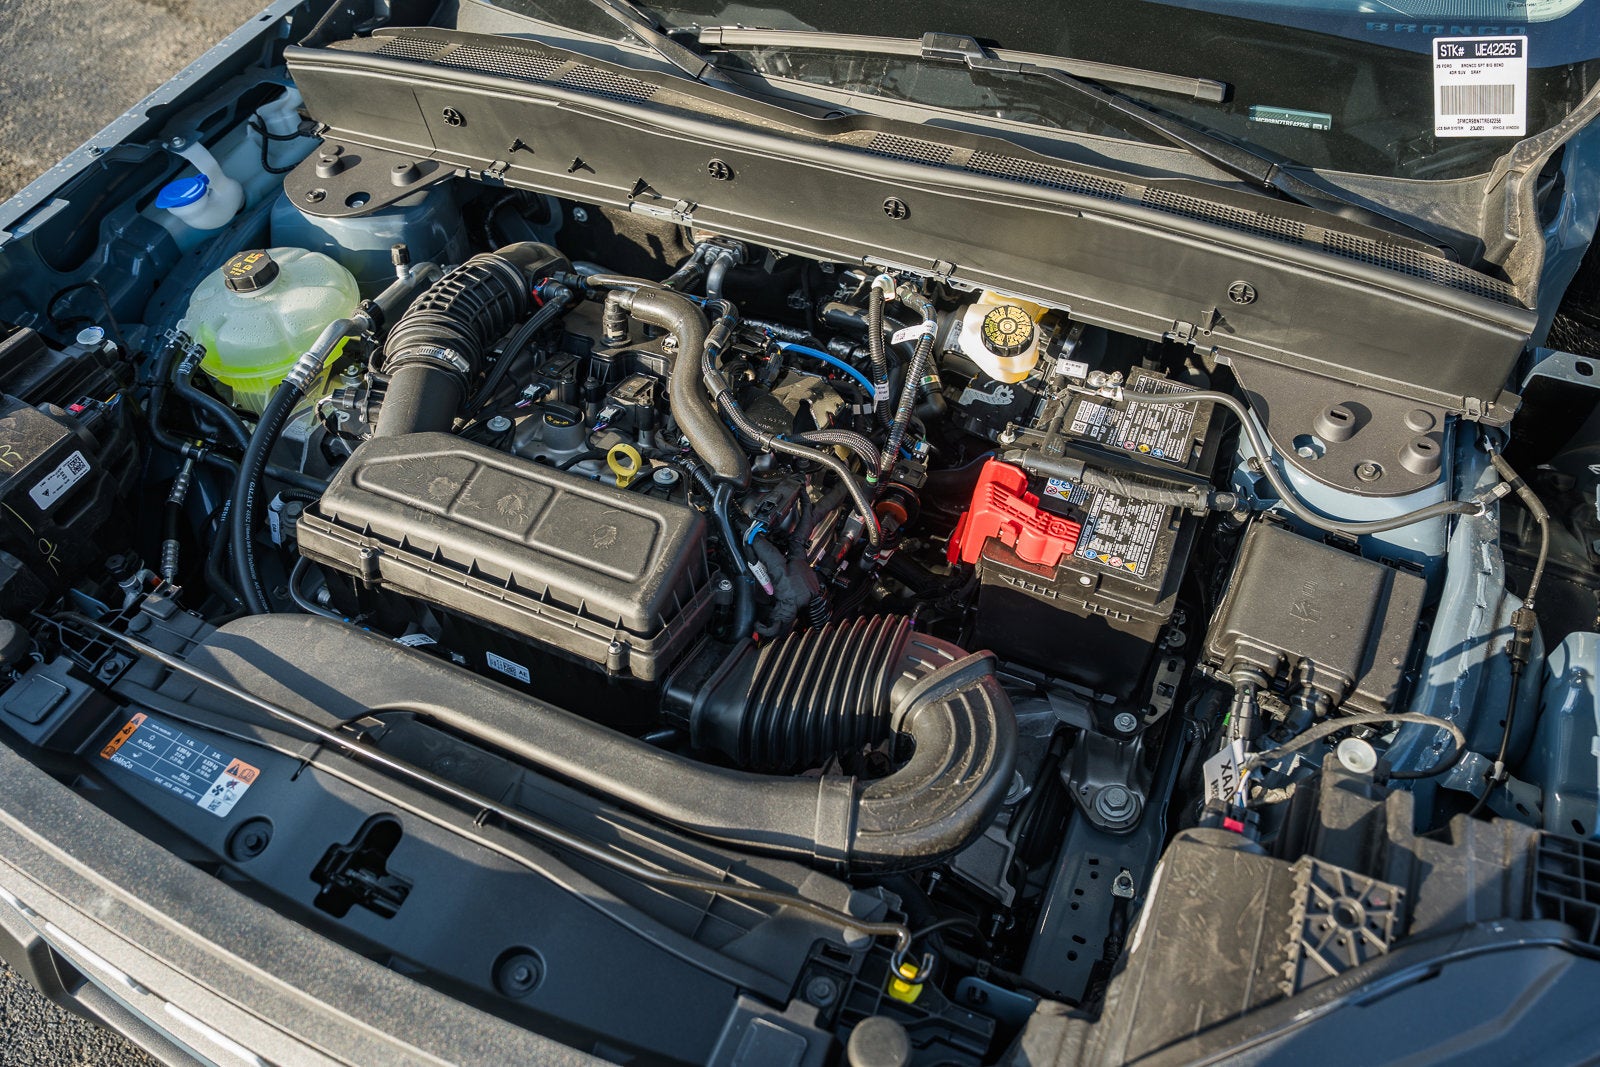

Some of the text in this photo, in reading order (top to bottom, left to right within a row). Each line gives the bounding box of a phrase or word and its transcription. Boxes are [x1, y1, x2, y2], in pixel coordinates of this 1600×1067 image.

[1440, 44, 1465, 57] STK#
[247, 482, 256, 508] GALAXY
[110, 753, 133, 769] FoMoCo
[1221, 759, 1233, 799] XAA
